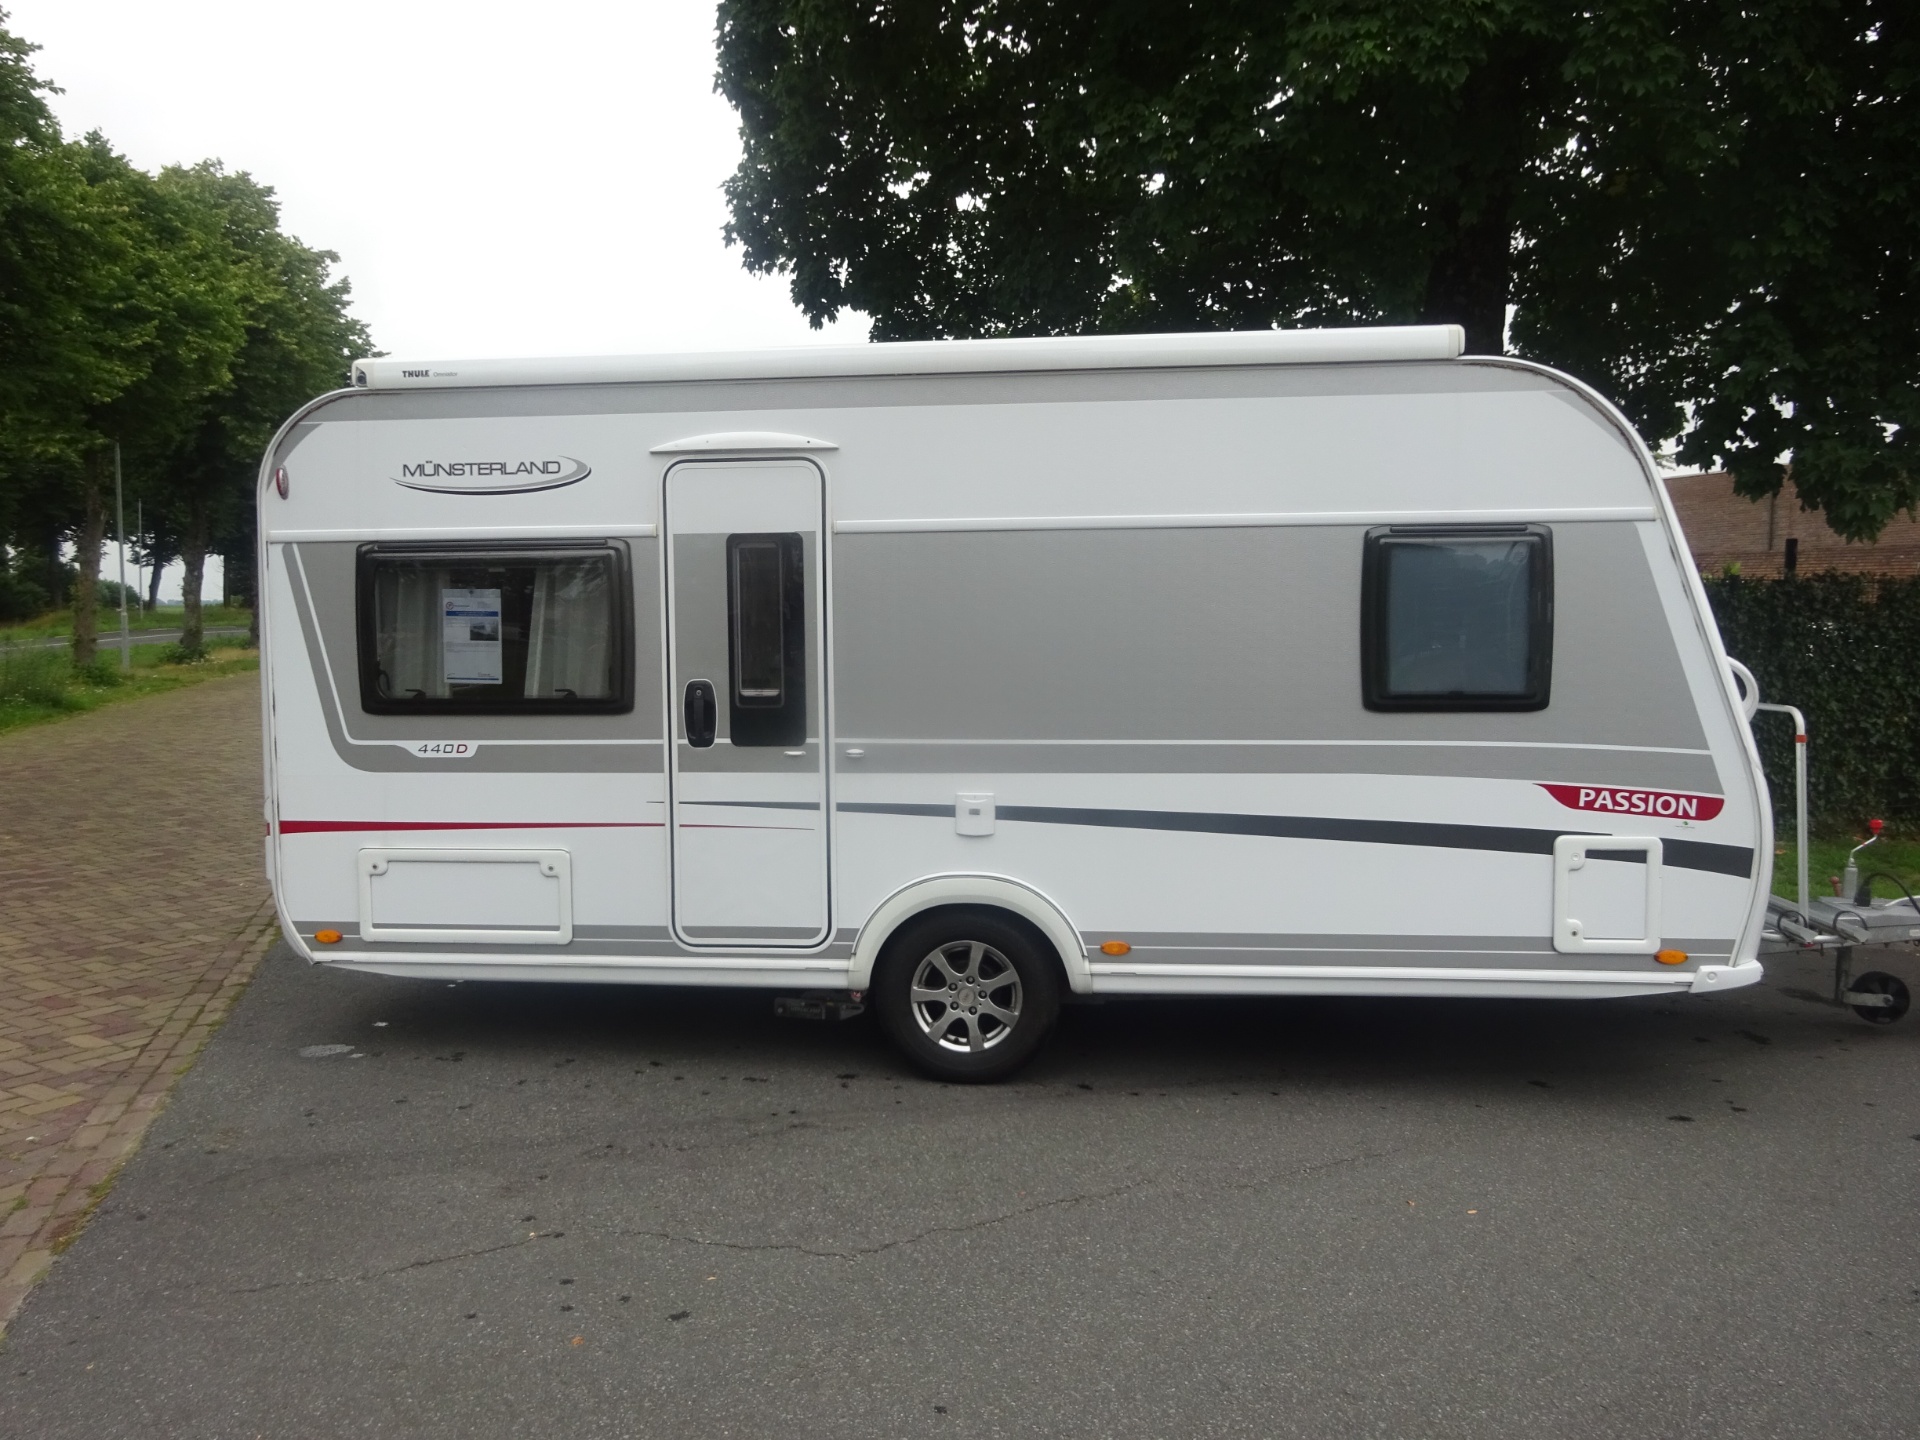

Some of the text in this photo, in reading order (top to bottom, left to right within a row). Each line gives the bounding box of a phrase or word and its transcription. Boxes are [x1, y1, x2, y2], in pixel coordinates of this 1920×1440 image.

[402, 369, 430, 378] THULE
[402, 460, 561, 477] MÜNSTERLAND
[1578, 788, 1698, 817] PASSION
